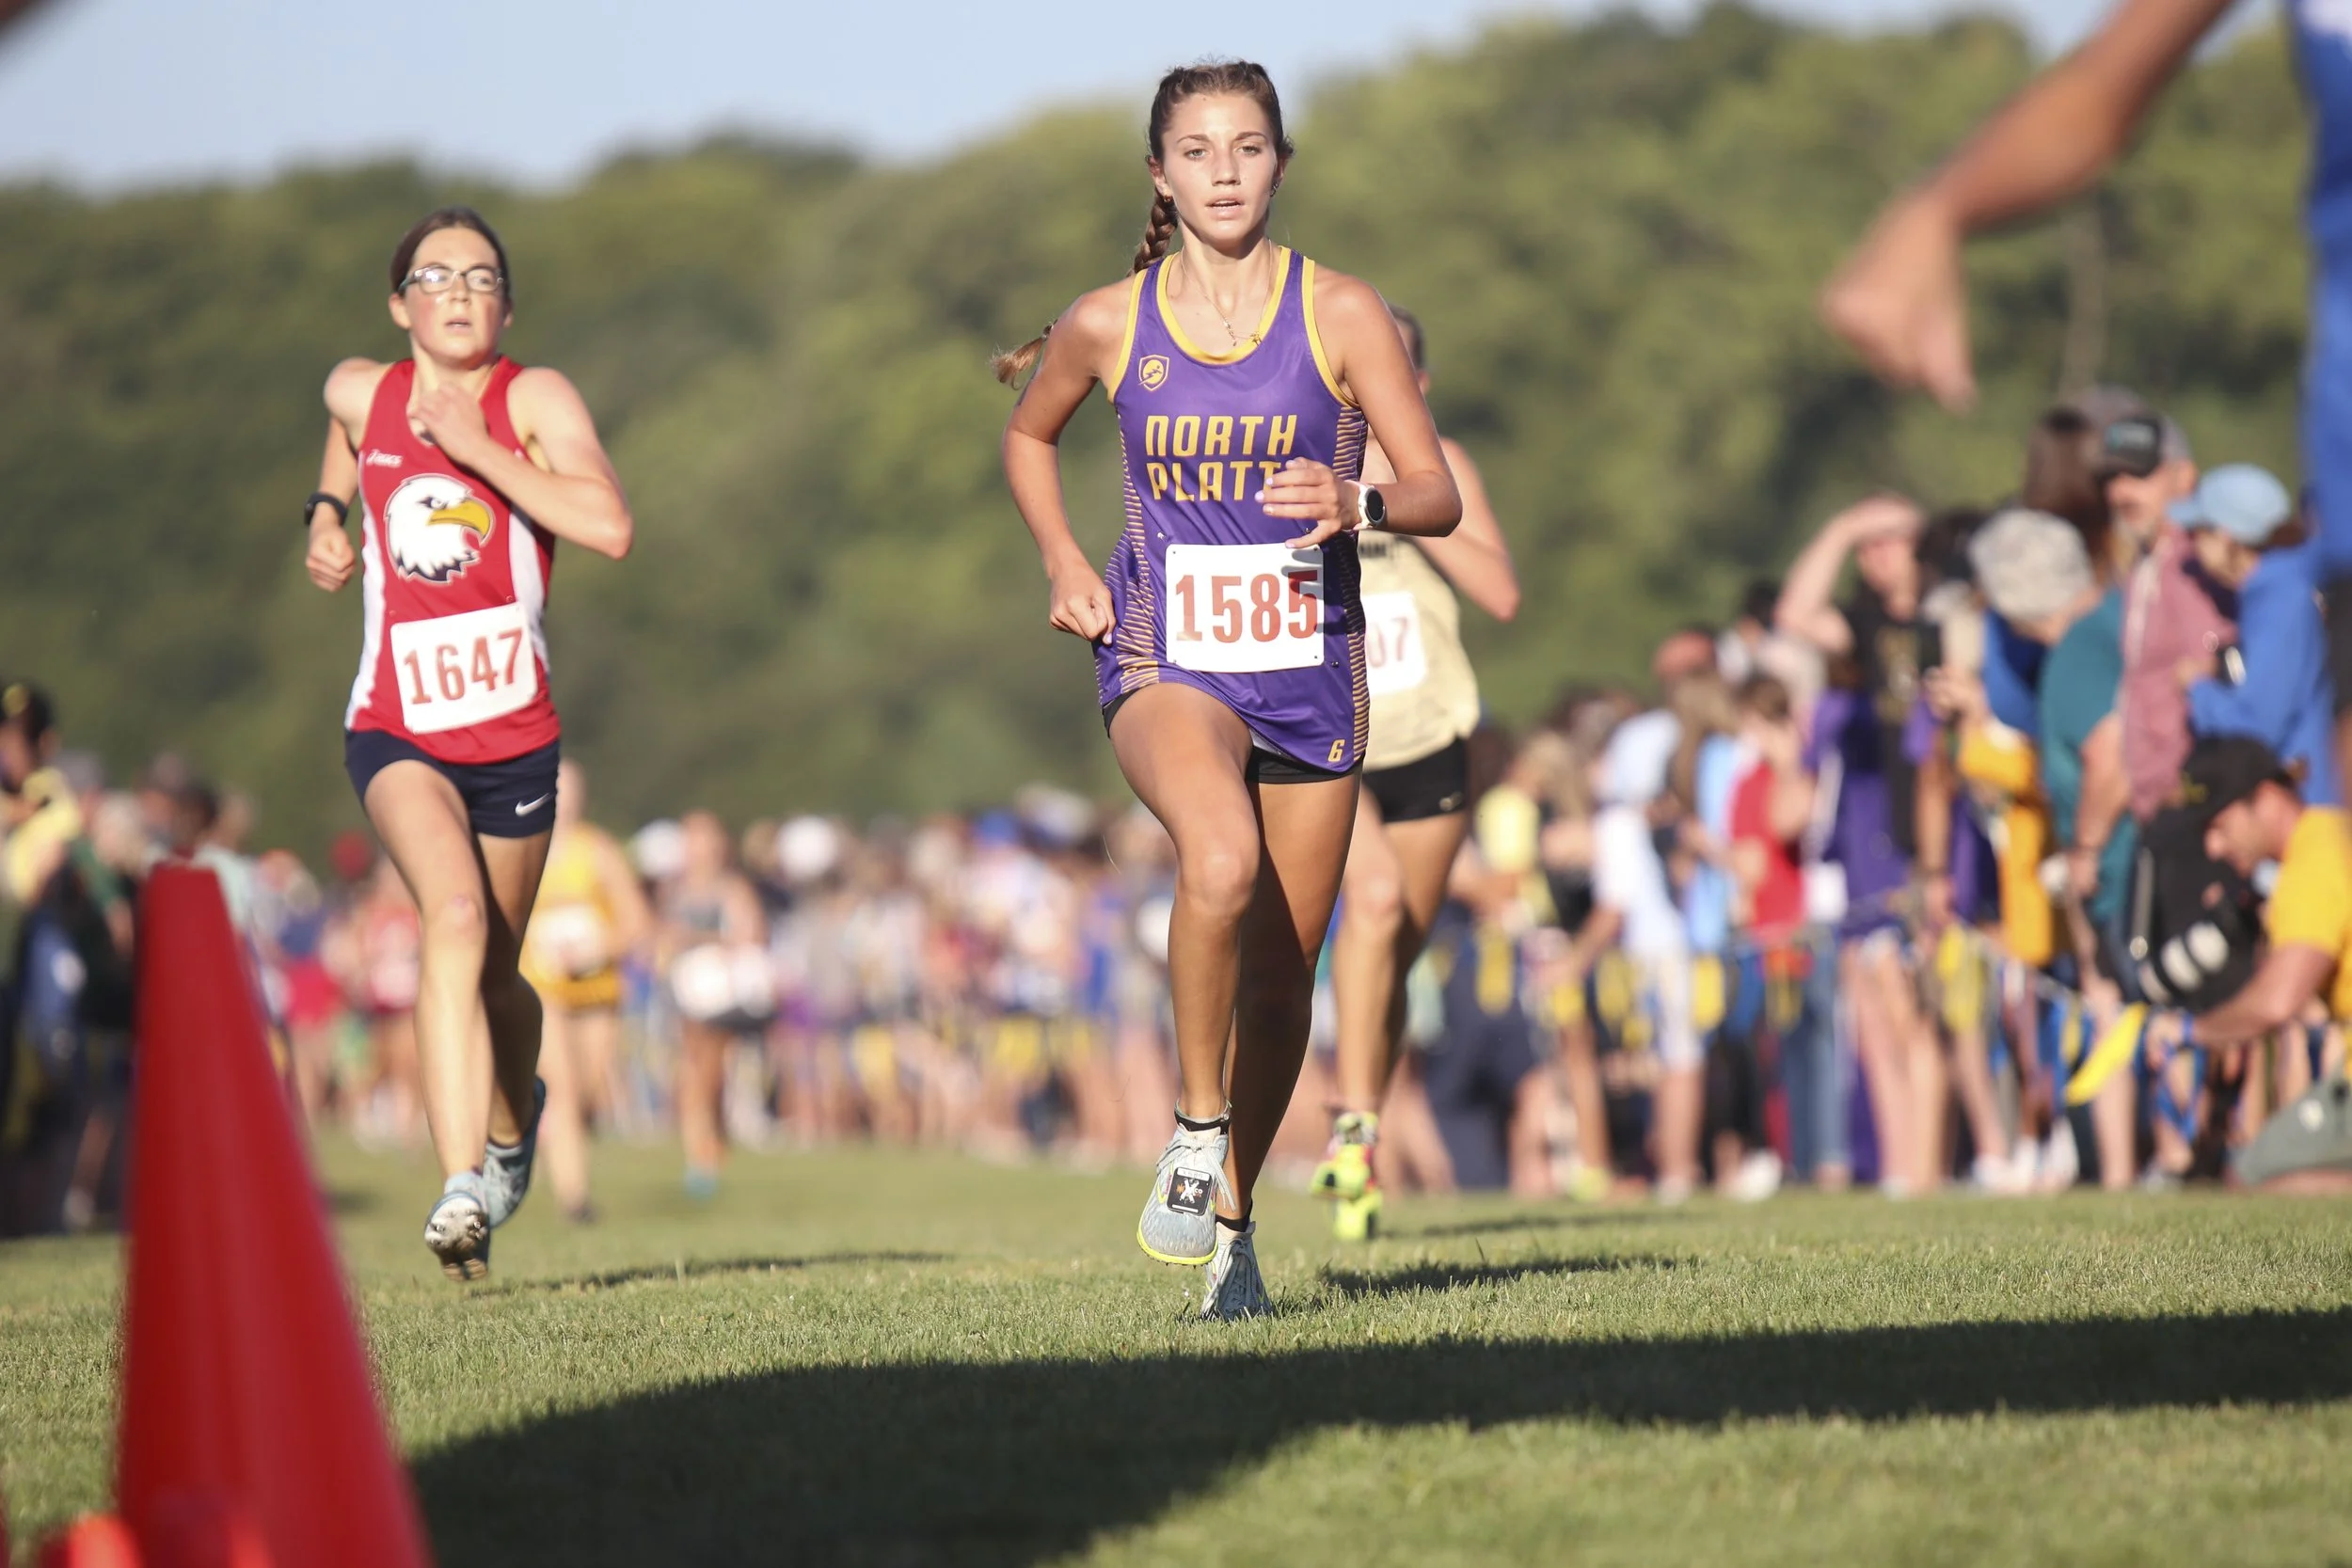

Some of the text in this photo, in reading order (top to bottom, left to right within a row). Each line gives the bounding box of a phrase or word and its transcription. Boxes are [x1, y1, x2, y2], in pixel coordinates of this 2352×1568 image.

[1145, 414, 1297, 456] NORTH
[1146, 461, 1282, 501] PLATT
[1175, 570, 1318, 643] 1585
[404, 627, 524, 705] 1647
[1327, 739, 1345, 762] 6
